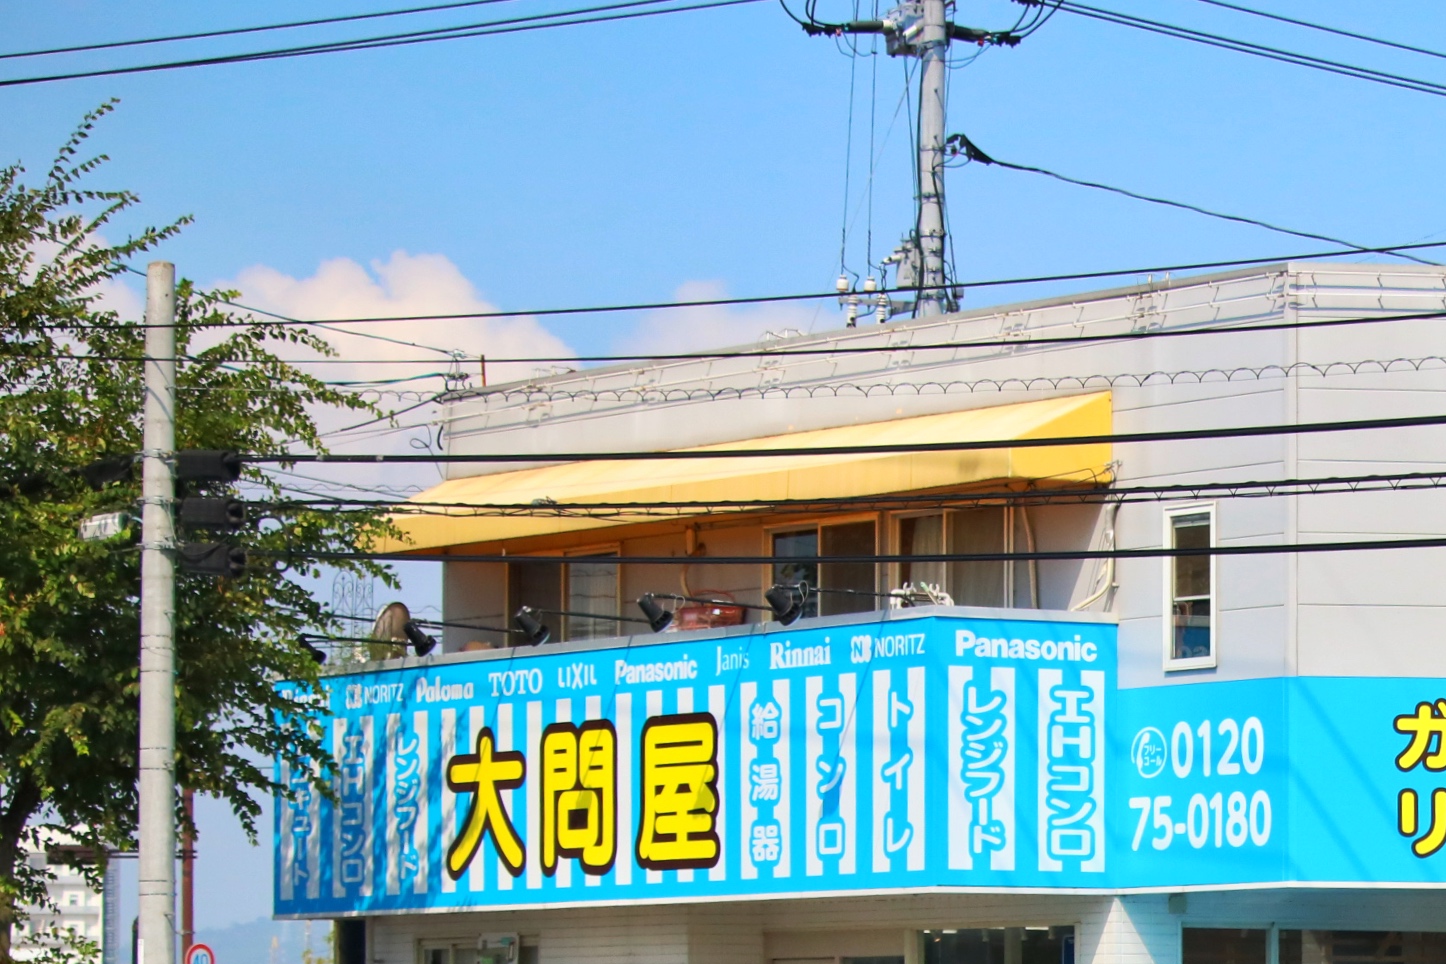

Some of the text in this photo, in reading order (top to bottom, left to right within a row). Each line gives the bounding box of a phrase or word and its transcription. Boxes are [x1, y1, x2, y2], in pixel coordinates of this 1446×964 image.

[364, 683, 404, 705] NORITZ
[416, 676, 474, 703] Paloma
[488, 668, 543, 697] TOTO
[558, 662, 597, 690] LIXIL
[615, 654, 698, 685] Panasonic
[716, 645, 750, 676] Janis
[769, 637, 831, 670] Rinnai
[874, 633, 926, 660] NORITZ
[955, 630, 1097, 663] Panasonic
[396, 731, 417, 879] レンジフード
[448, 713, 720, 879] 大問屋
[751, 700, 779, 863] 給湯器
[818, 697, 843, 855] コンロ
[884, 691, 911, 854] トイレ
[965, 686, 1005, 854] レンジフード
[1129, 789, 1272, 852] 75-0180
[1171, 716, 1264, 779] 0120
